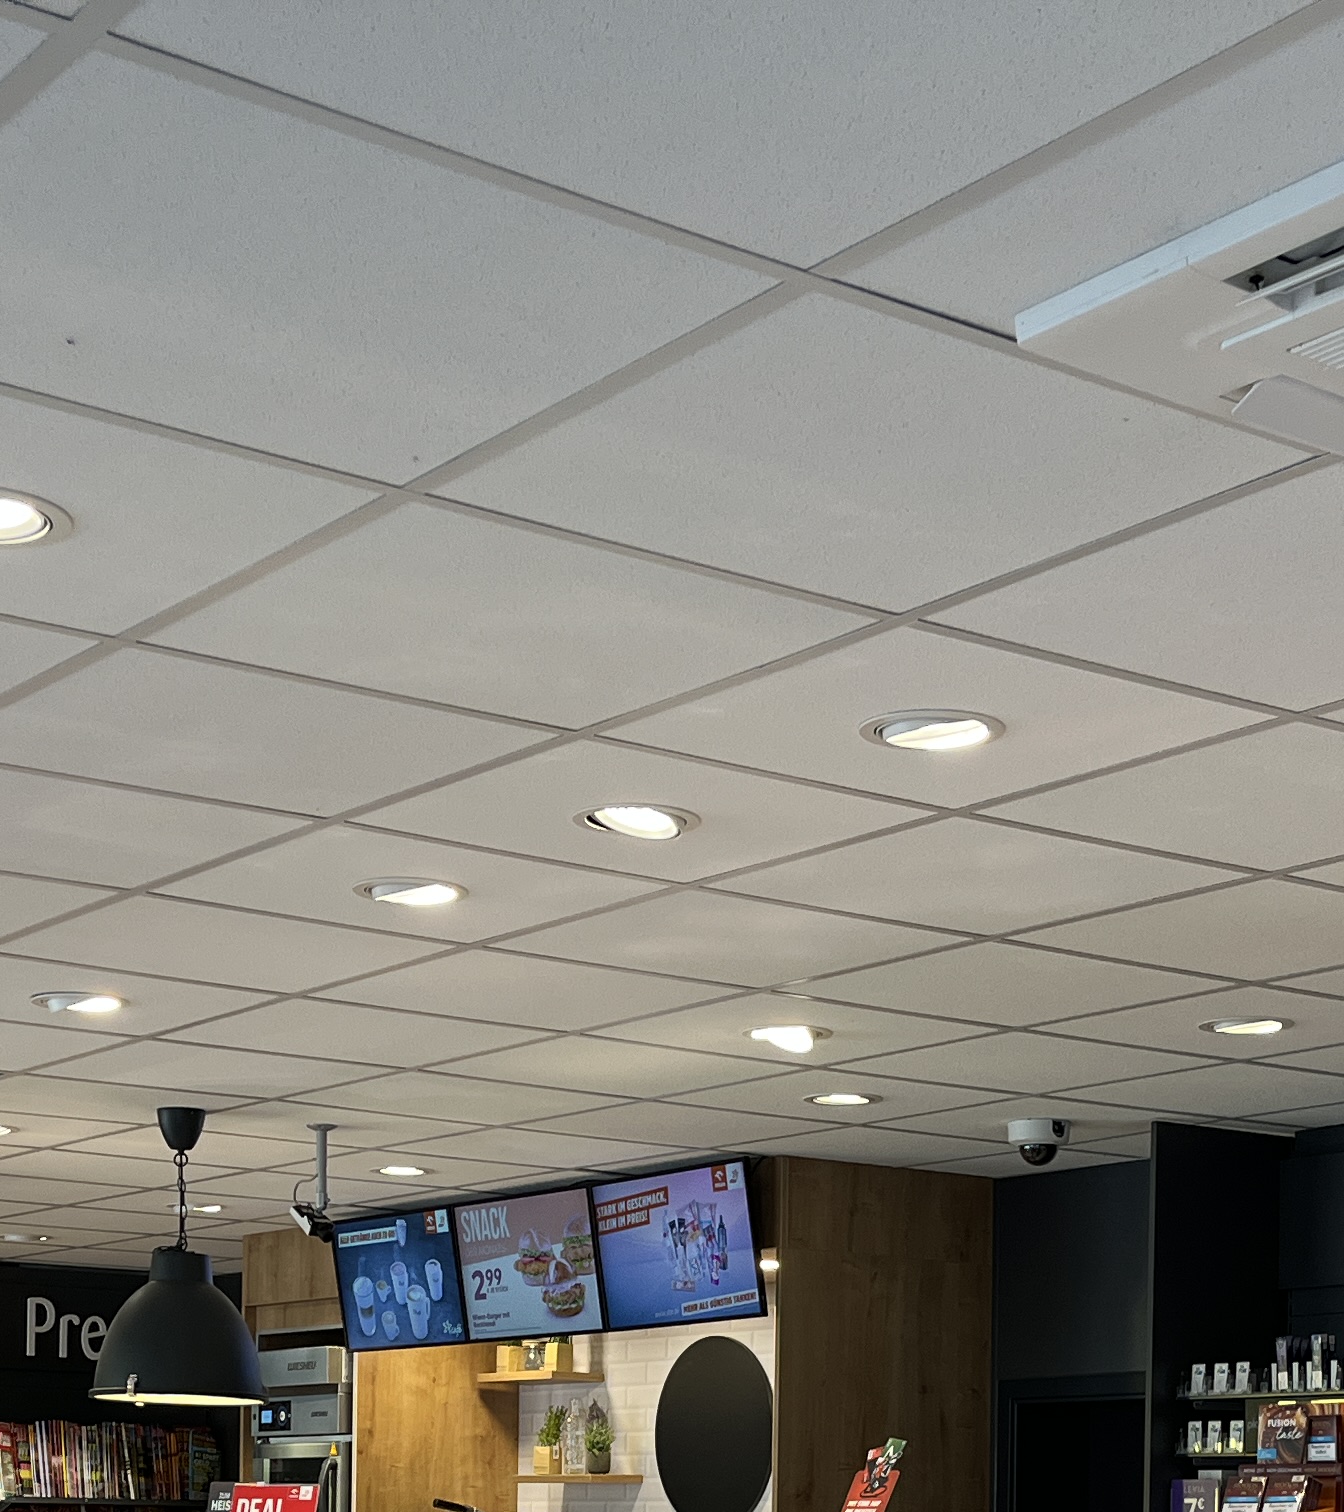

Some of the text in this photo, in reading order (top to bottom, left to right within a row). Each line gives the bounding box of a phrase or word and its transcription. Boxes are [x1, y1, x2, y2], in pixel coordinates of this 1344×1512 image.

[460, 1206, 510, 1243] SNACK
[25, 1297, 107, 1359] Pre
[1267, 1418, 1296, 1428] FUSION
[1275, 1427, 1304, 1440] taste
[211, 1500, 232, 1511] HEIS
